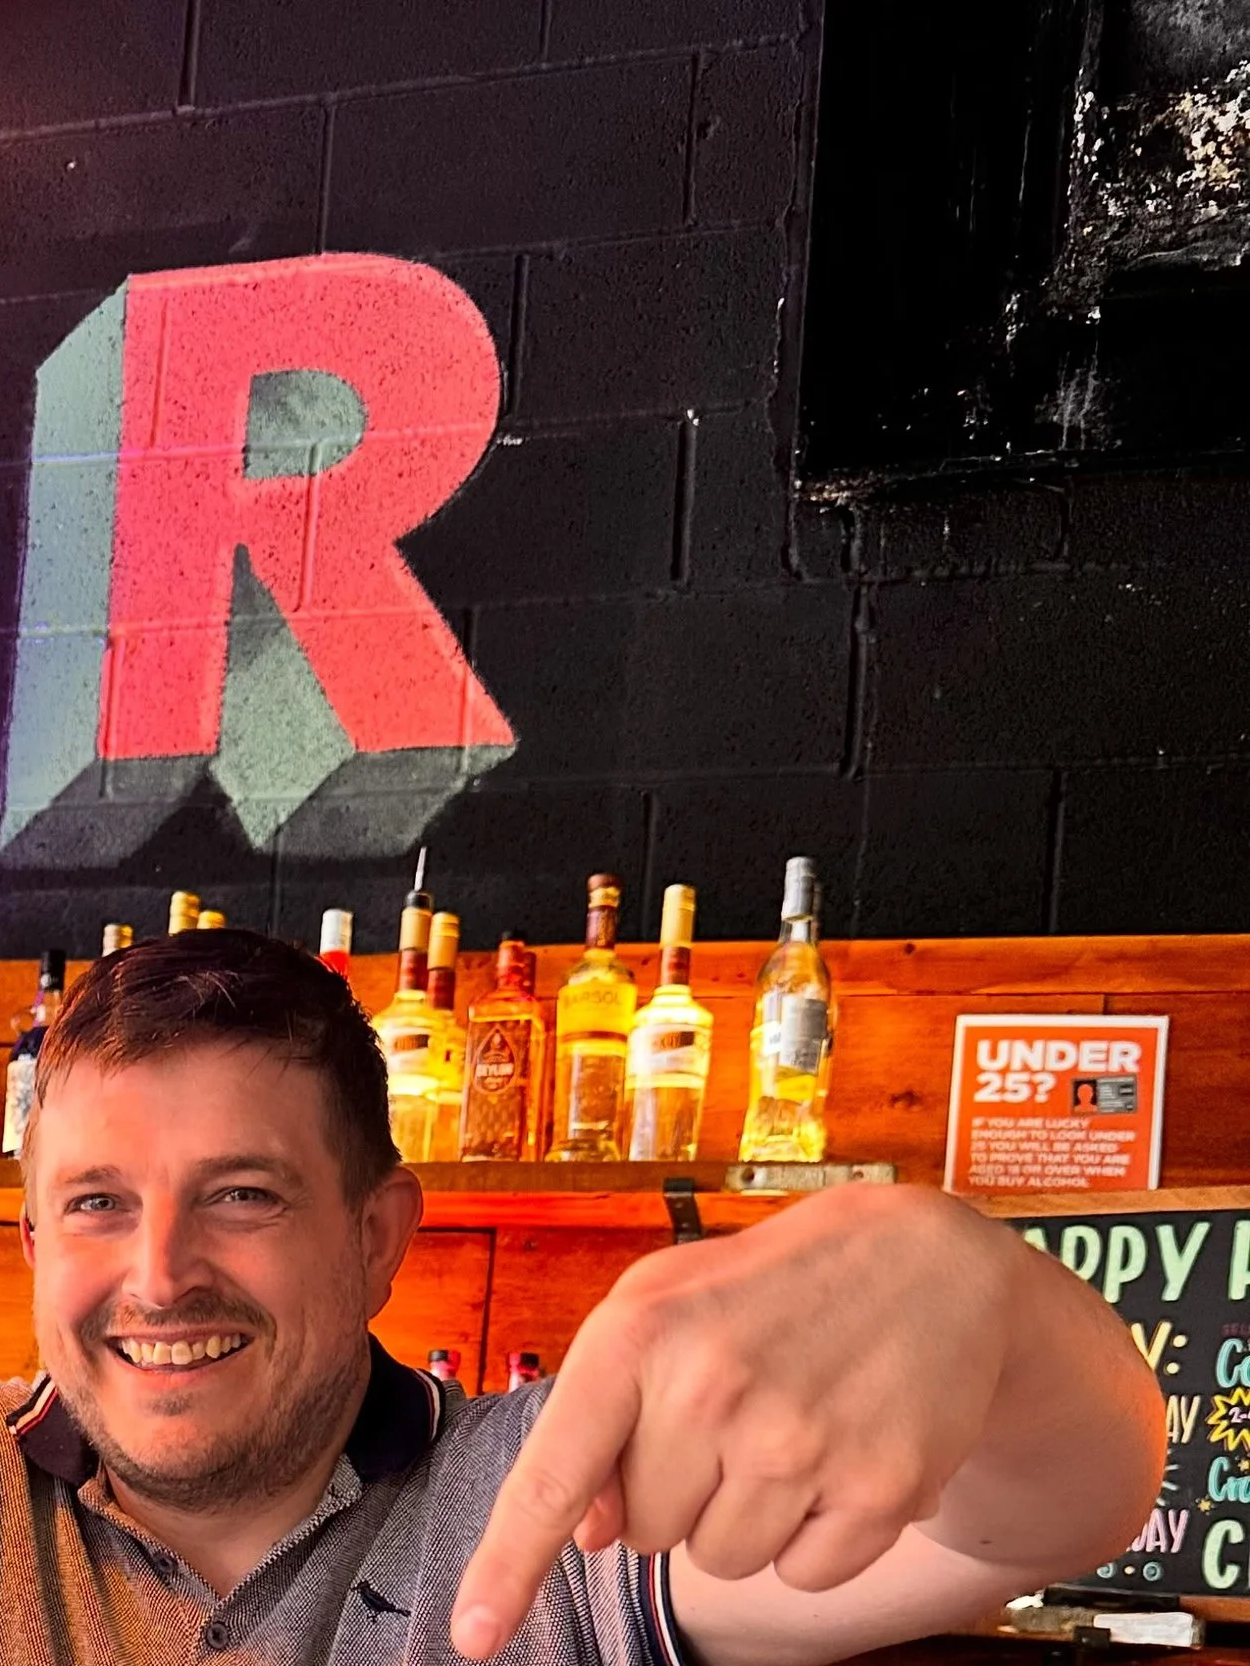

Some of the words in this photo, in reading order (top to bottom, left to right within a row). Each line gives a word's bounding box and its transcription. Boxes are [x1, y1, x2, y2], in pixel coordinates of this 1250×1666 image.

[976, 1039, 1141, 1073] UNDER
[973, 1072, 1056, 1104] 25?
[988, 1118, 1014, 1128] YOU
[1016, 1118, 1044, 1128] ARE
[1045, 1118, 1091, 1129] LUCKY
[1050, 1130, 1086, 1141] LOOK
[1088, 1130, 1136, 1141] UNDER
[989, 1141, 1016, 1151] YOU
[1019, 1142, 1049, 1152] WILL
[990, 1152, 1033, 1163] PROVE
[1073, 1153, 1100, 1164] YOU
[1102, 1153, 1131, 1165] ARE
[1044, 1165, 1081, 1176] OVER
[1084, 1166, 1127, 1177] WHEN
[1026, 1176, 1090, 1188] ALCOHOL
